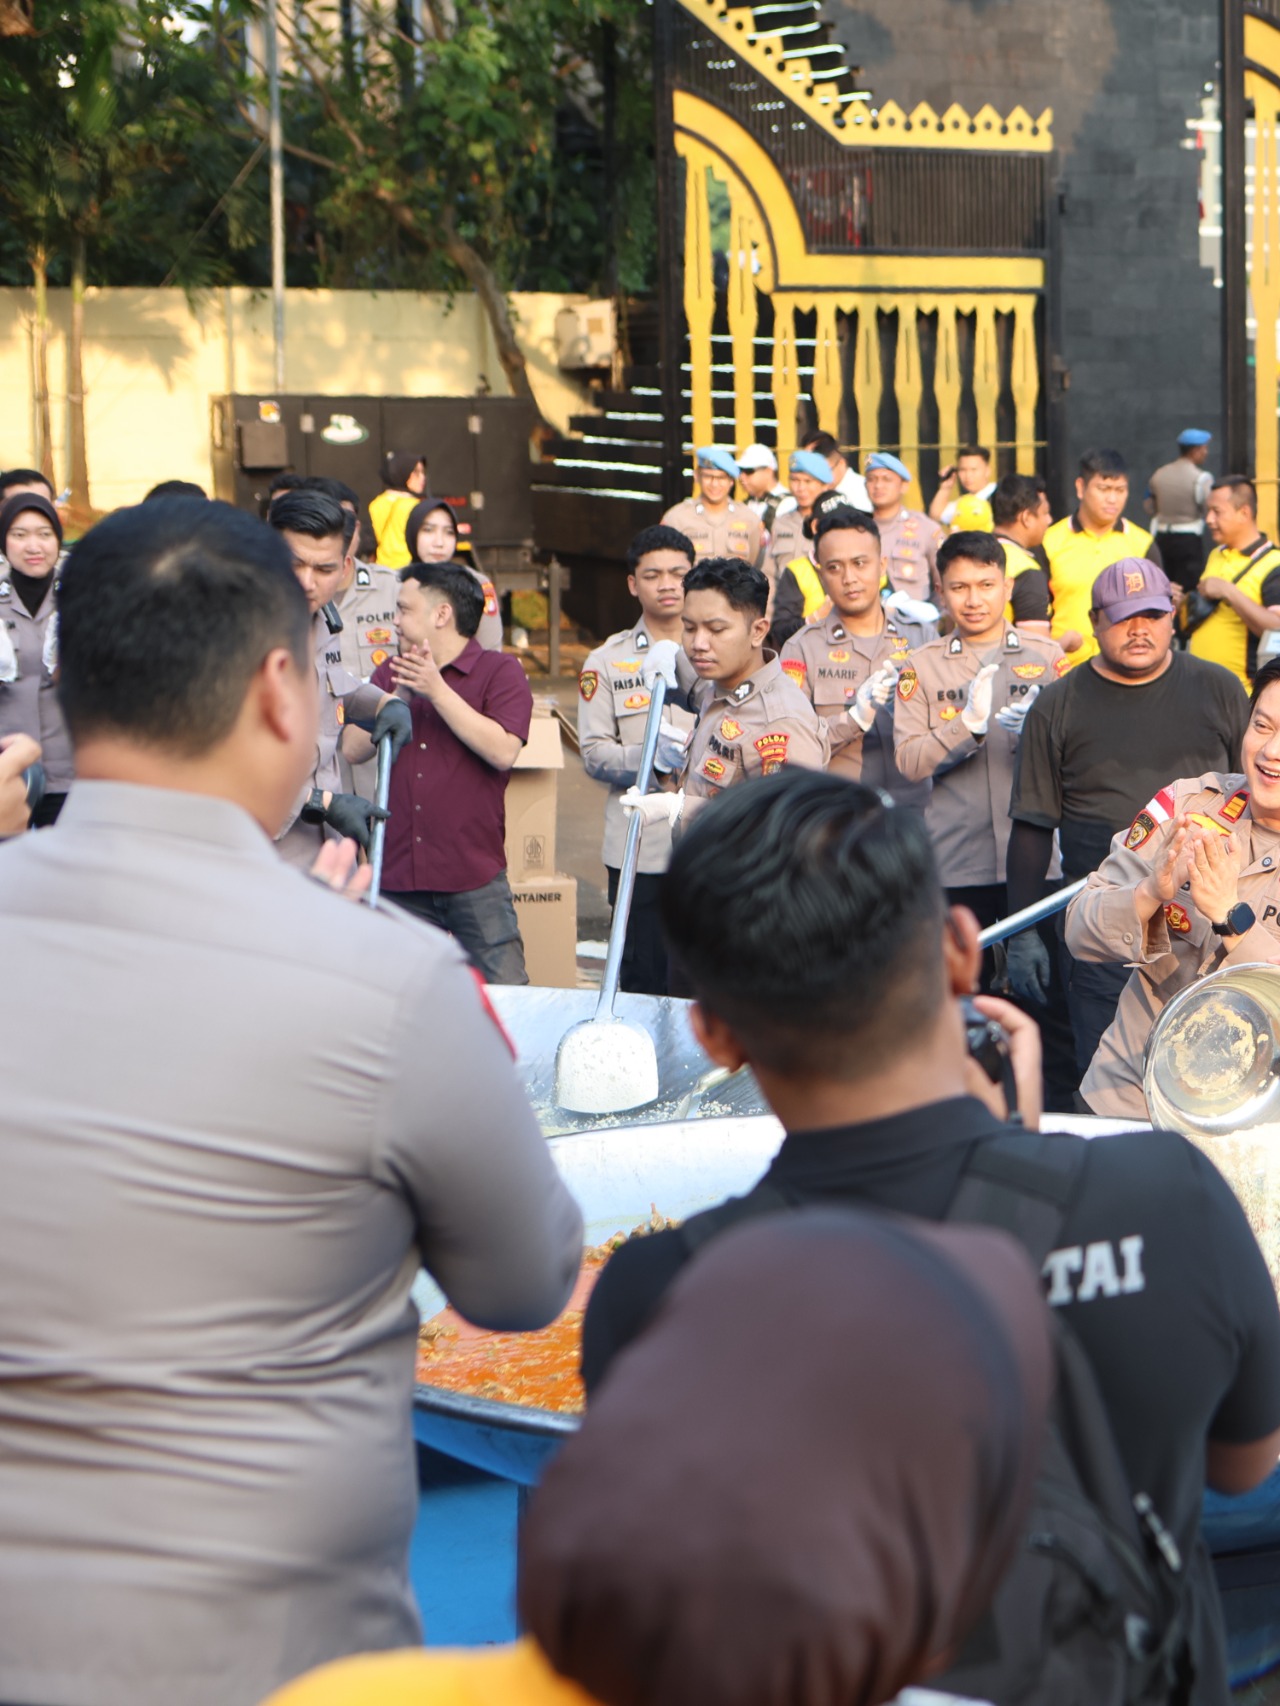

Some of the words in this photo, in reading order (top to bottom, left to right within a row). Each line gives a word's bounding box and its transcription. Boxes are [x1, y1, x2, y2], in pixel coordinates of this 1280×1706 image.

[818, 667, 858, 680] MAARIF
[937, 689, 964, 701] EGI
[757, 735, 785, 748] POLDA
[1041, 1235, 1145, 1307] TAI
